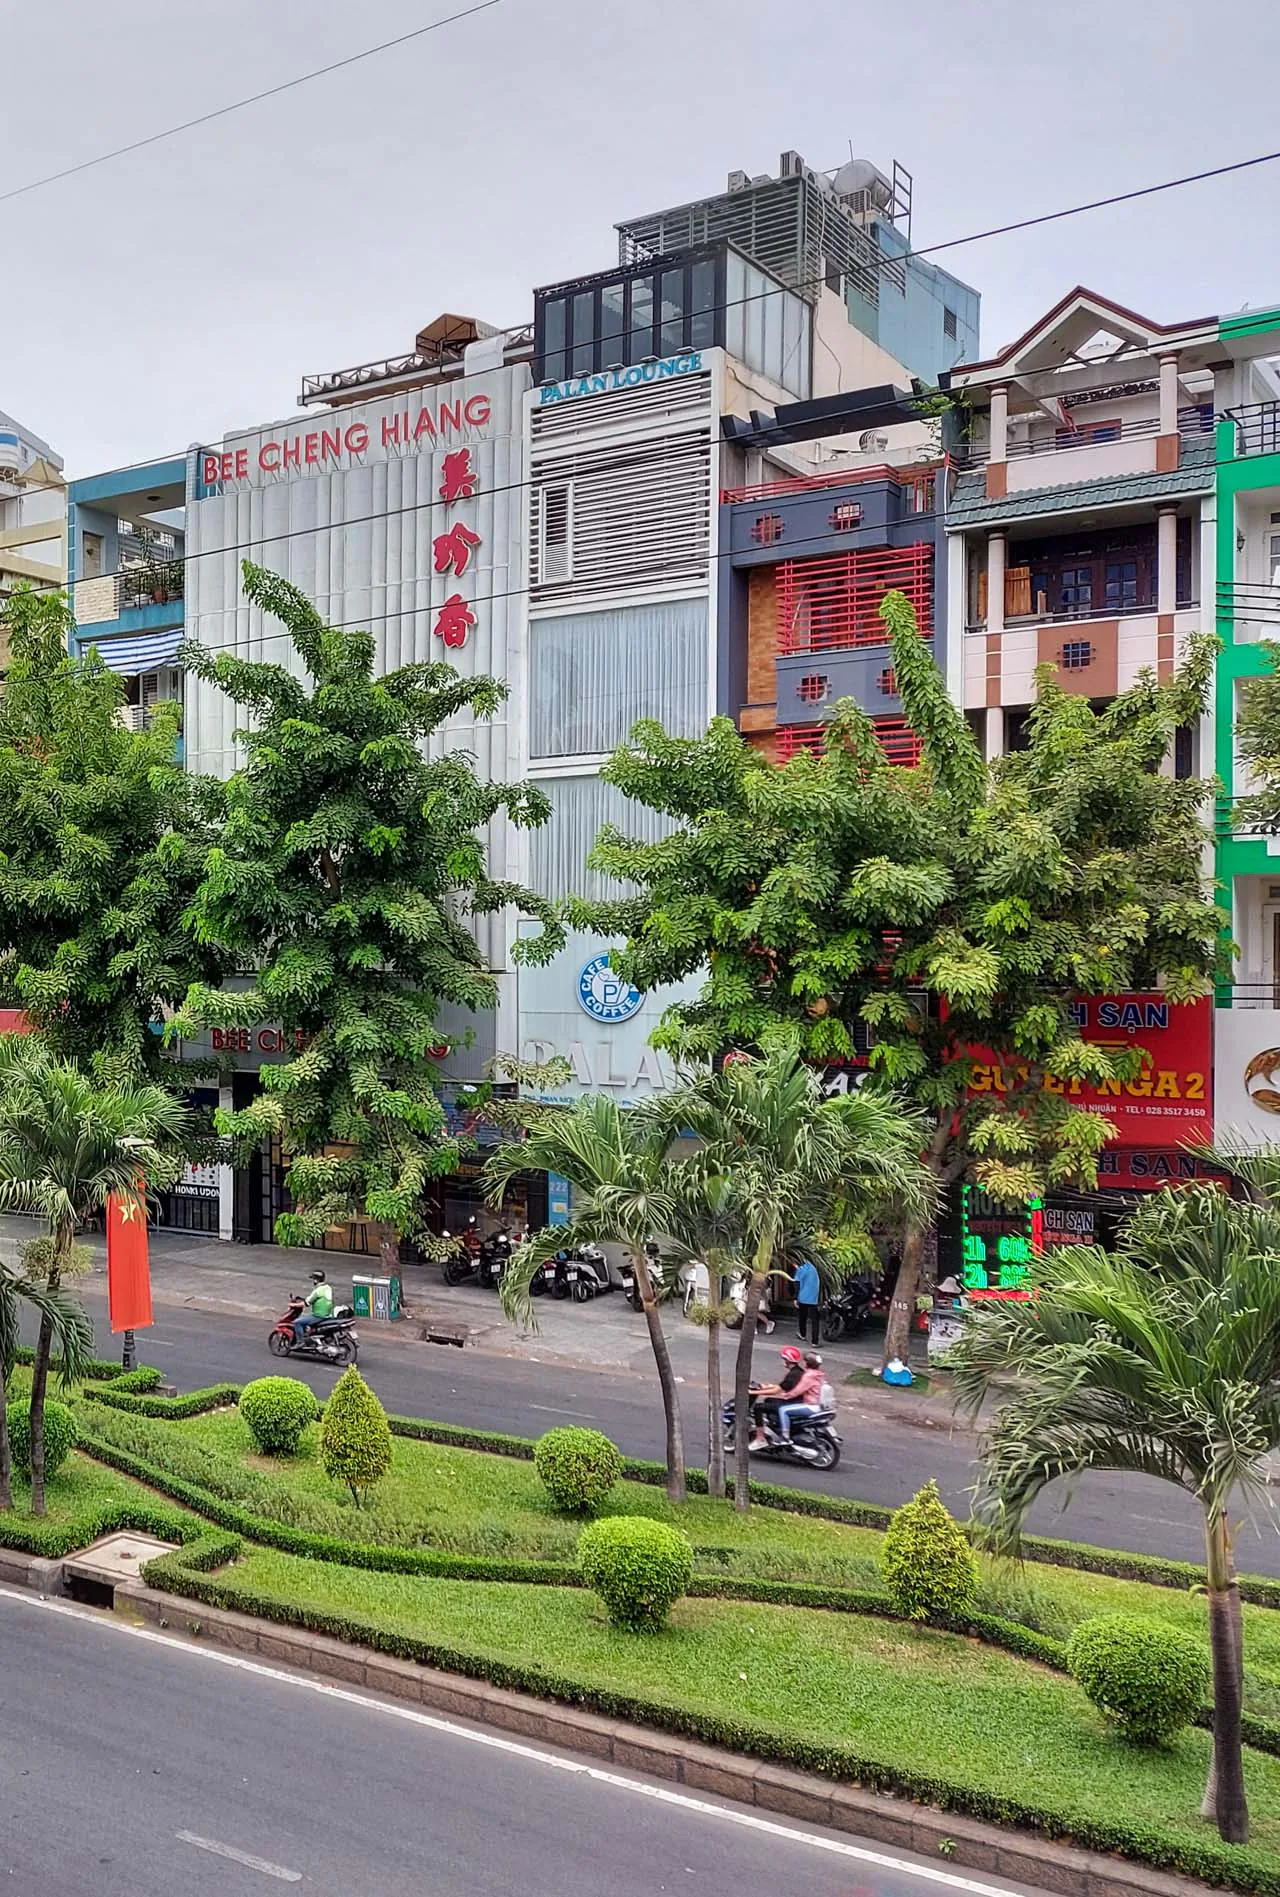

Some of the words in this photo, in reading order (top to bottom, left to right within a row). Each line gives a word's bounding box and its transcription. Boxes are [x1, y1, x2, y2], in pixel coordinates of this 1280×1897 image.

[540, 374, 608, 404] PALAN
[613, 352, 702, 388] LOUNGE
[204, 448, 249, 484] BEE
[259, 422, 369, 472] CHENG
[381, 394, 491, 448] HIANG
[581, 959, 605, 992] CAFE
[585, 997, 636, 1017] COFFEE
[1098, 1002, 1169, 1034] SẠN
[212, 1027, 251, 1051] BEE
[1186, 1072, 1205, 1100] 2
[1145, 1106, 1161, 1115] 028
[1162, 1106, 1183, 1116] 3517
[1184, 1107, 1206, 1117] 3450
